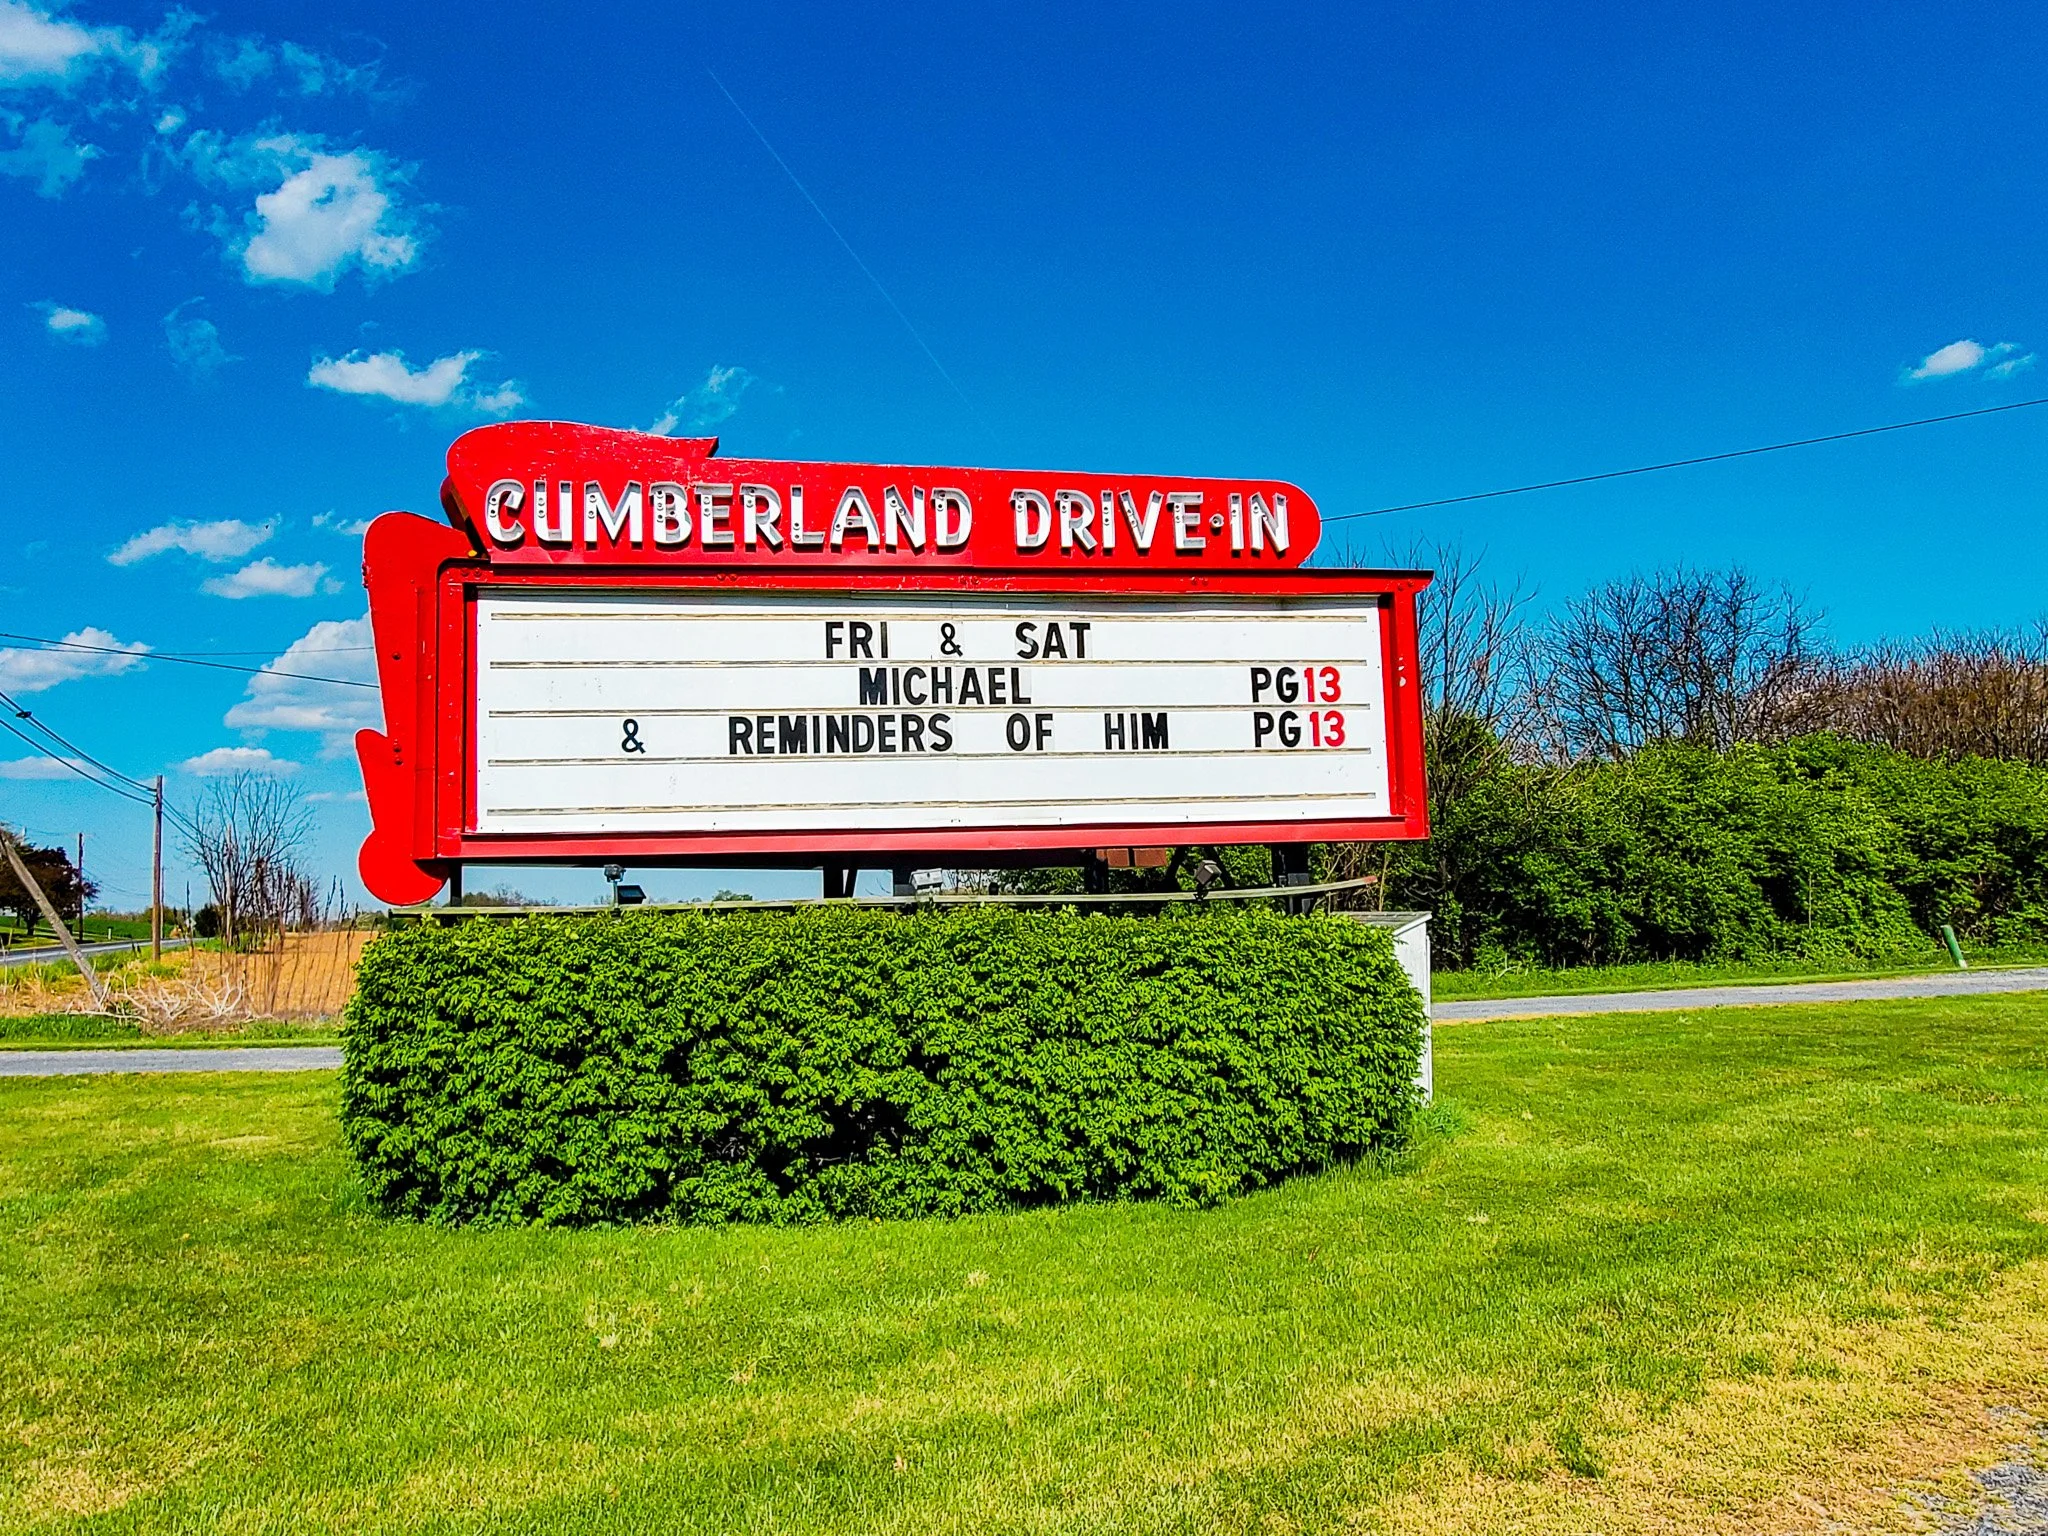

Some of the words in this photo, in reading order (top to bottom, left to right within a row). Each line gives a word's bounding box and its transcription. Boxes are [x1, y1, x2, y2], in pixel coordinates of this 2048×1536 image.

[485, 478, 973, 548] CUMBERLAND
[825, 620, 888, 659] FRI
[940, 622, 964, 656] &
[1016, 621, 1092, 659] SAT
[858, 667, 1031, 706] MICHAEL
[1251, 666, 1342, 703] PG13
[621, 718, 646, 754] &
[728, 713, 953, 755] REMINDERS
[1006, 713, 1054, 752] OF
[1104, 712, 1169, 751] HIM
[1254, 710, 1346, 748] PG13
